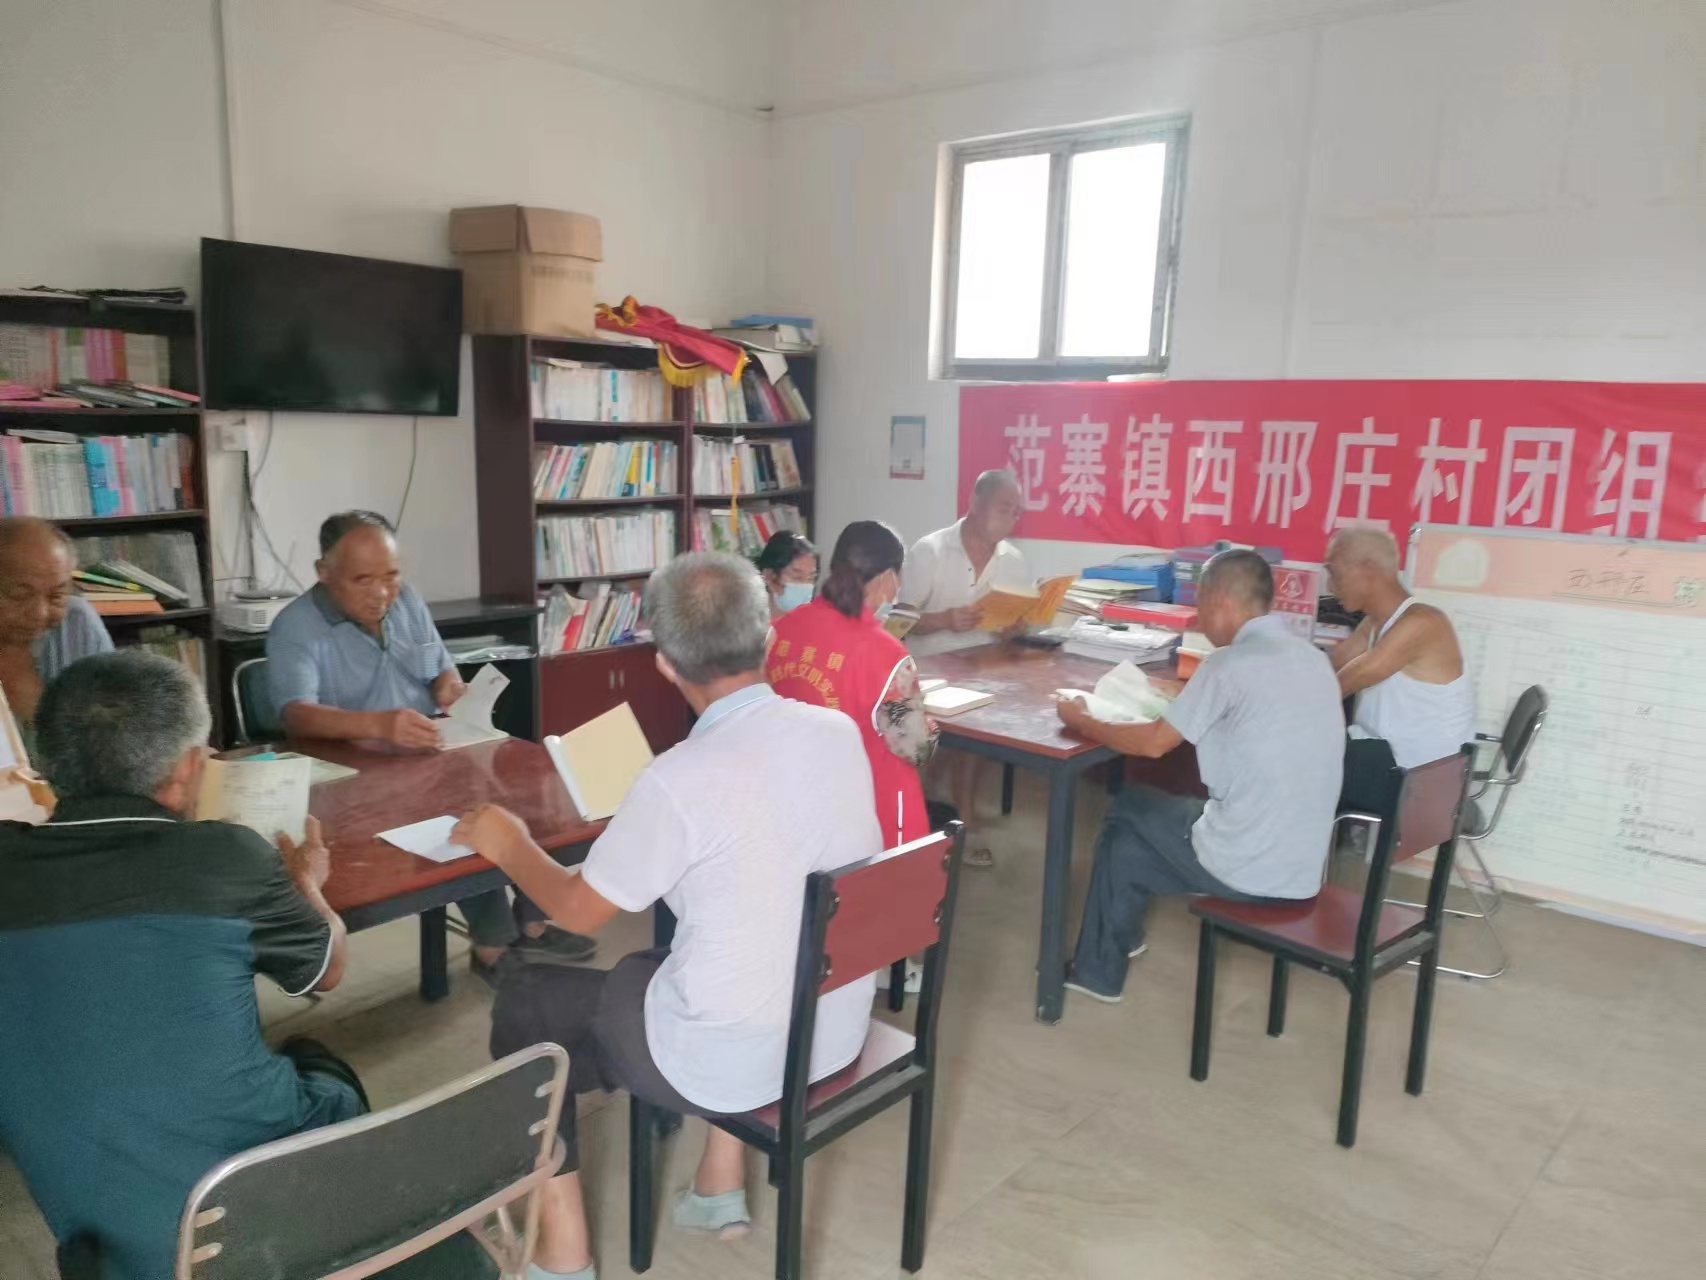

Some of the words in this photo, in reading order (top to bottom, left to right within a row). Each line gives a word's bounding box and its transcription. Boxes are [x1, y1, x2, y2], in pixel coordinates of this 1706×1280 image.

[1003, 413, 1706, 541] 范寨镇西邢庄村团组
